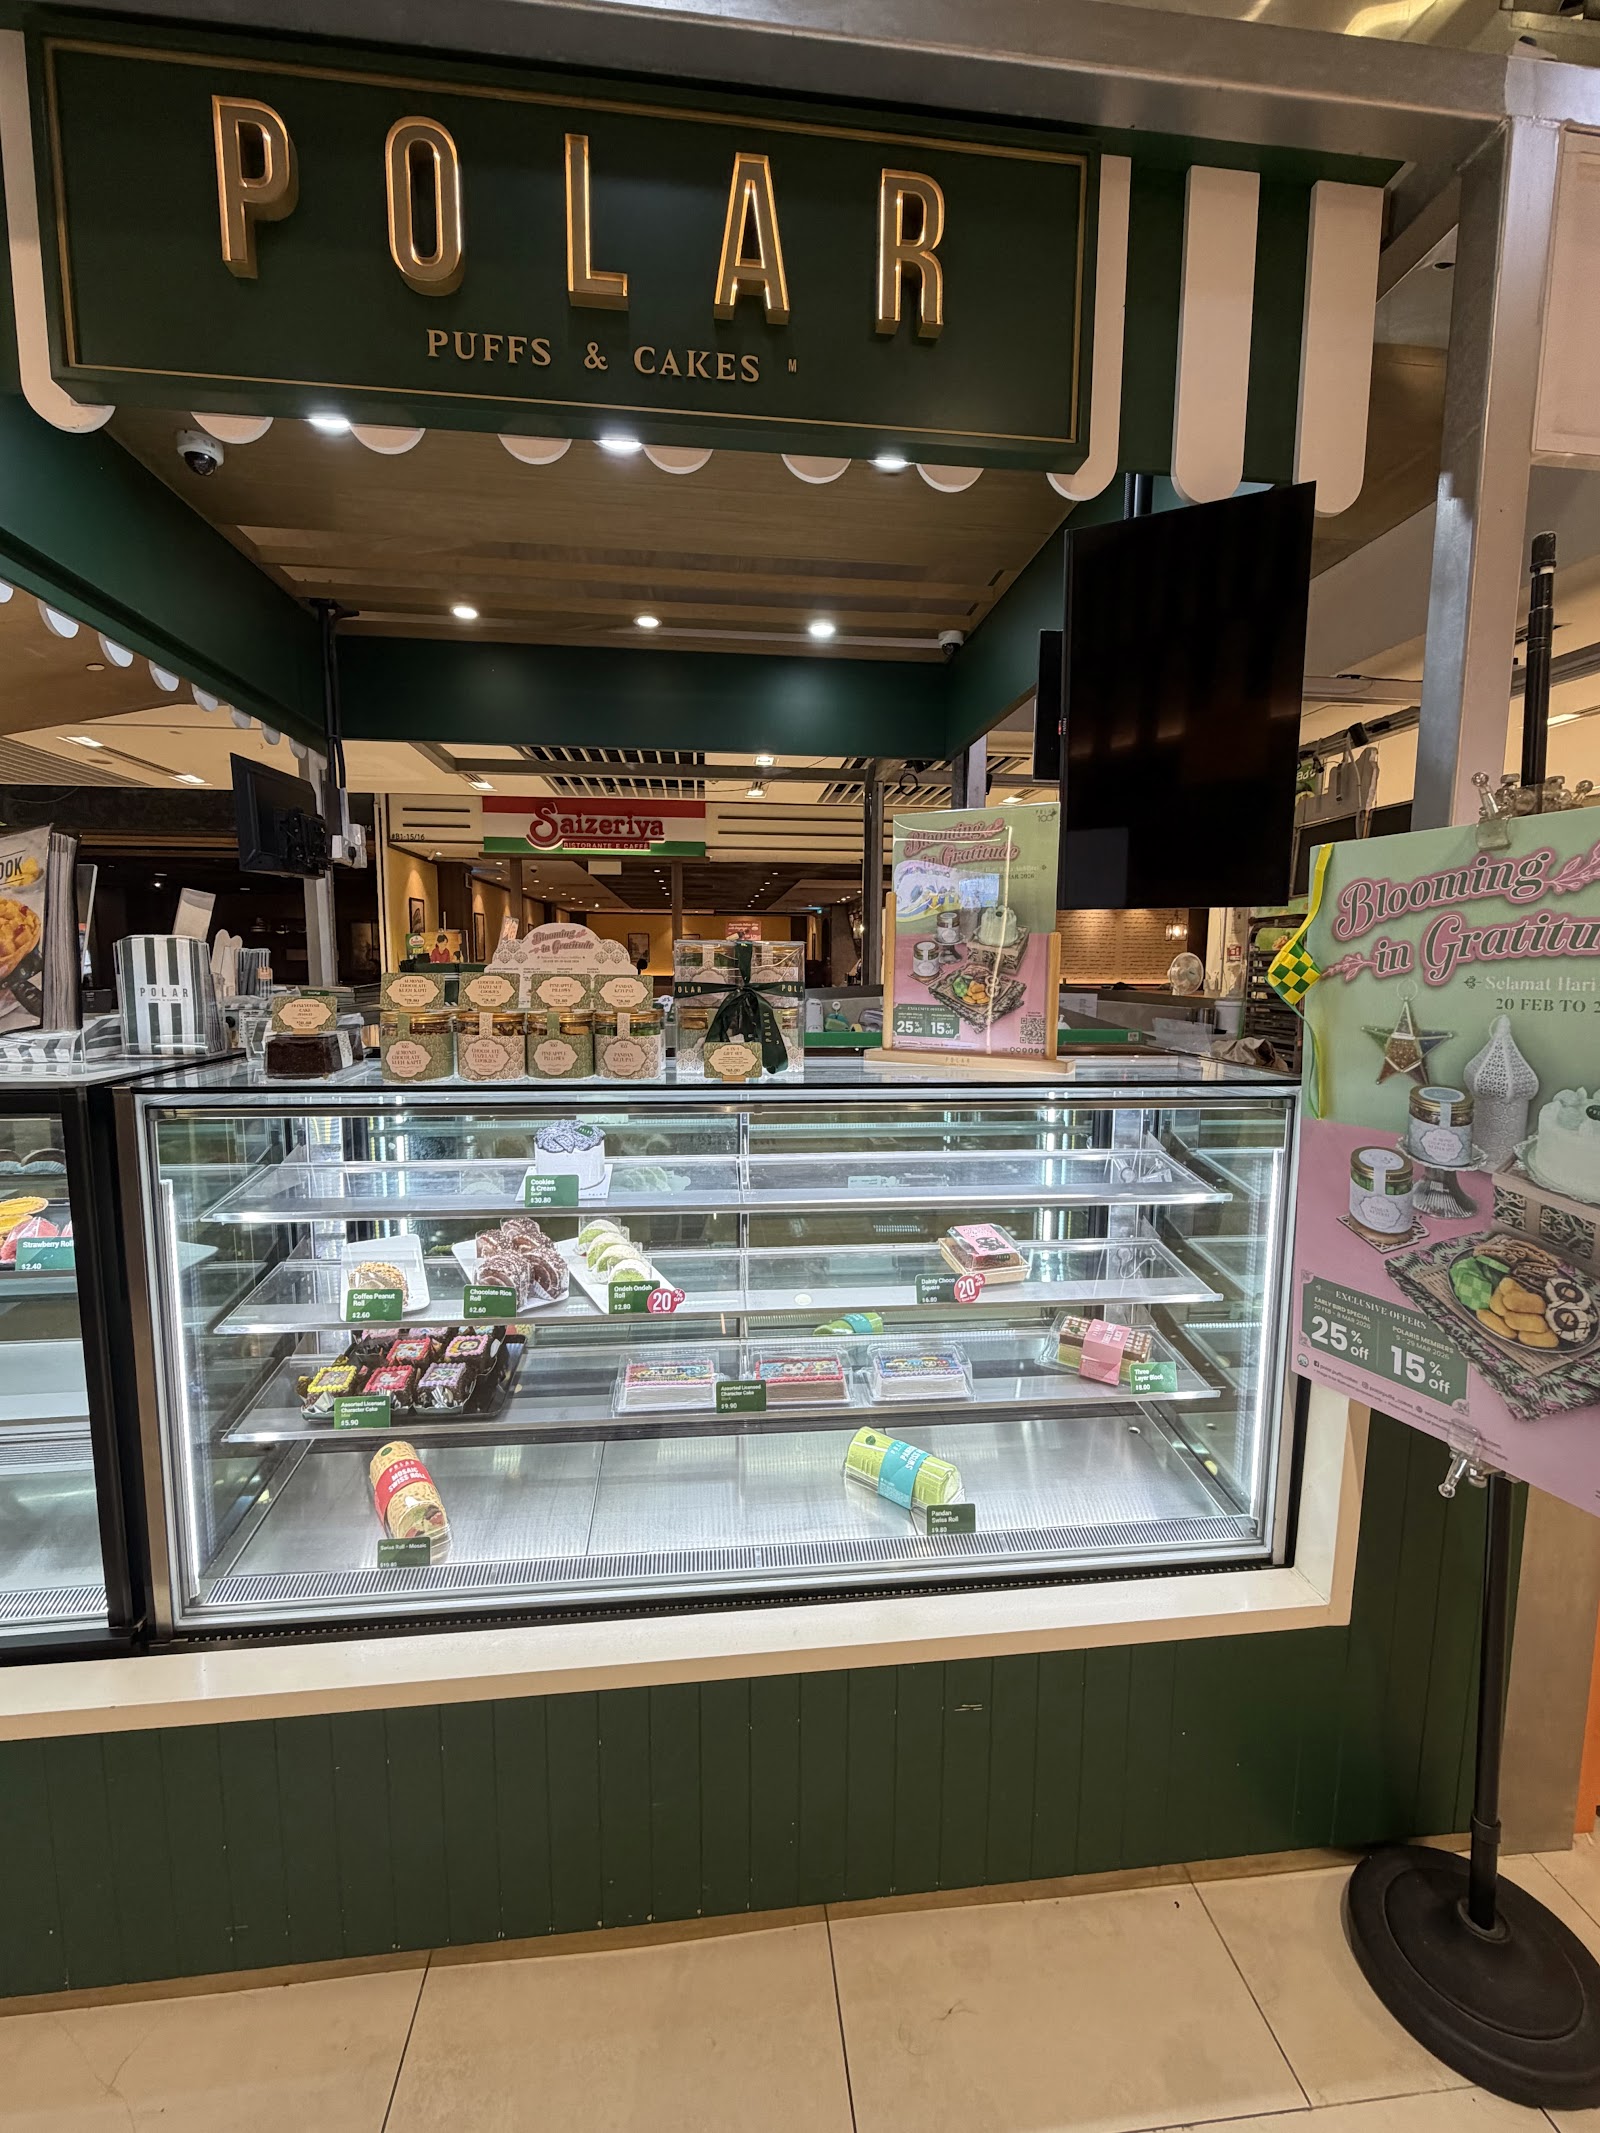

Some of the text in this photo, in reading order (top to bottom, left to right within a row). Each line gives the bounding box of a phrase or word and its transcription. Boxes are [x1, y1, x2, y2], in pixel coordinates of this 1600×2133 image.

[212, 95, 945, 337] POLAR
[427, 329, 552, 367] PUFFS
[584, 342, 608, 370] &
[634, 346, 760, 383] CAKES
[528, 802, 665, 844] Saizeriya
[563, 841, 612, 849] RISTORANTE
[906, 821, 983, 856] Blooming
[941, 844, 1018, 867] Gratitude
[1337, 851, 1551, 938] Blooming
[1376, 913, 1600, 982] in Gratitu
[140, 987, 189, 998] POLAR
[1485, 976, 1596, 991] Selamat Hari
[1496, 998, 1515, 1010] 20
[1520, 998, 1554, 1012] FEB
[1559, 1000, 1586, 1013] TO
[897, 1020, 914, 1033] 25
[931, 1022, 945, 1034] 15
[22, 1240, 60, 1249] Strawberry
[958, 1277, 976, 1299] 20
[652, 1292, 672, 1311] 20
[1314, 1296, 1371, 1322] EARLY BIRD SPECIAL
[1335, 1290, 1427, 1330] EXCLUSIVE OFFERS
[1321, 1307, 1332, 1315] FEB
[1341, 1315, 1355, 1323] MAR
[1311, 1315, 1369, 1360] 25 % off
[1392, 1325, 1454, 1353] POLARIS MEMBERS
[1406, 1338, 1415, 1347] 29
[1416, 1343, 1431, 1353] MAR
[1432, 1349, 1450, 1360] 2026
[1391, 1345, 1450, 1395] 15 % off
[388, 1472, 427, 1493] SWISS ROLL
[391, 1467, 419, 1482] MOSAIC
